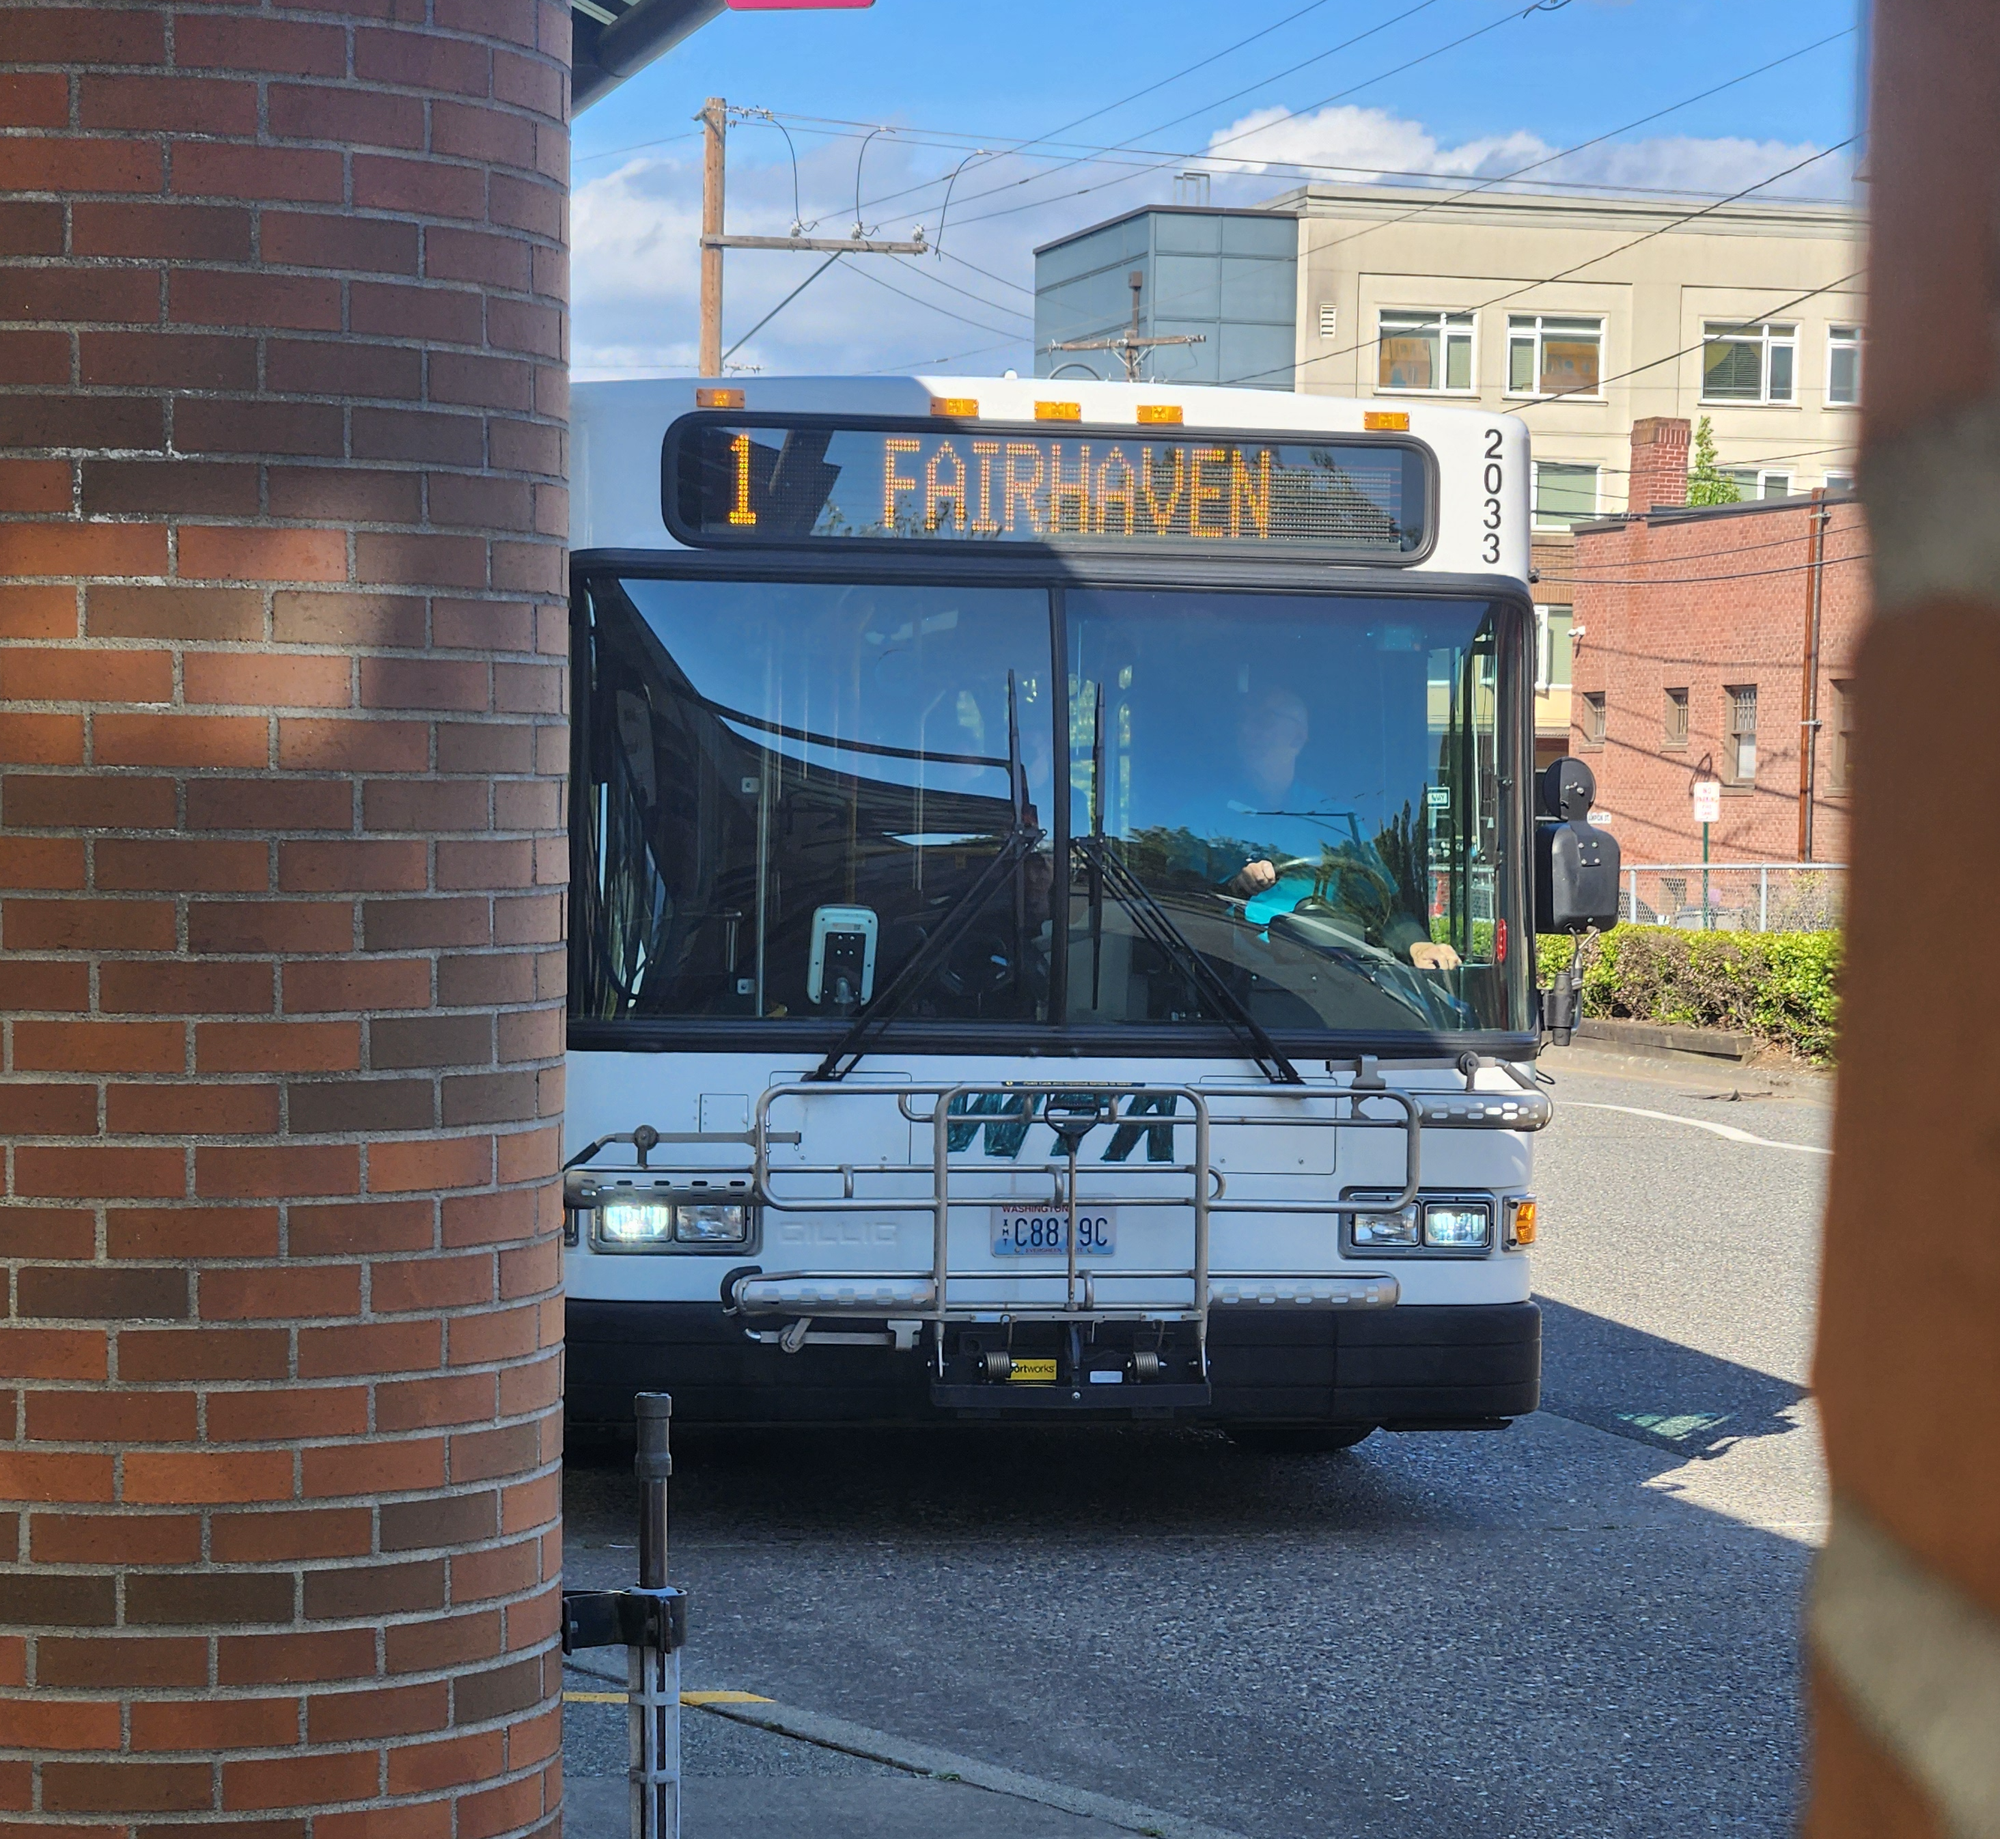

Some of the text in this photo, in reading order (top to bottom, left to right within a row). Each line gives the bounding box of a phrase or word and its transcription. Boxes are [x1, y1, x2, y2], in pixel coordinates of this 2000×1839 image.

[729, 434, 1271, 539] 1 FAIRHAVEN
[1482, 428, 1503, 564] 2033
[1002, 1204, 1069, 1213] WASHINGTON
